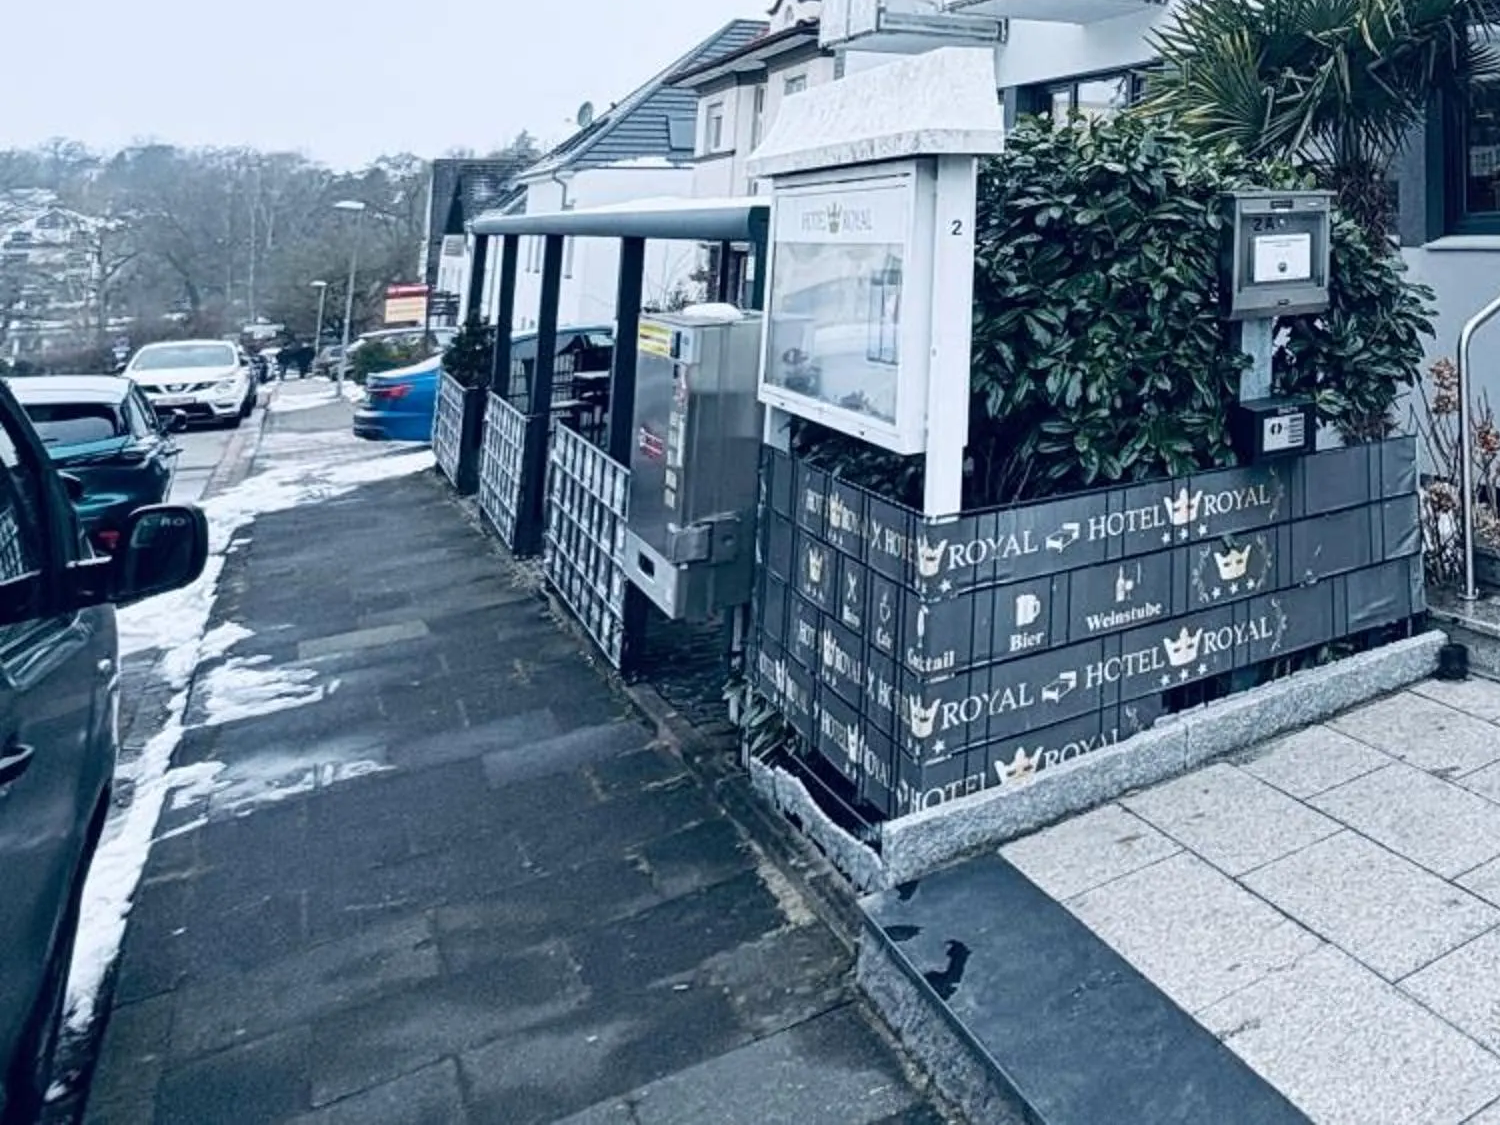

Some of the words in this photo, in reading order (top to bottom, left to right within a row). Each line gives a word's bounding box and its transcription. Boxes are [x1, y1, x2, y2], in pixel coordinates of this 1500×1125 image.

[951, 219, 963, 236] 2
[947, 530, 1039, 571] ROYAL
[1088, 505, 1165, 542] HOTEL
[1203, 486, 1272, 517] ROYAL
[1086, 601, 1163, 632] Weinstube
[1009, 630, 1045, 652] Bier
[939, 681, 1034, 731] ROYAL
[1085, 646, 1165, 690] HOTEL
[1203, 616, 1274, 655] ROYAL
